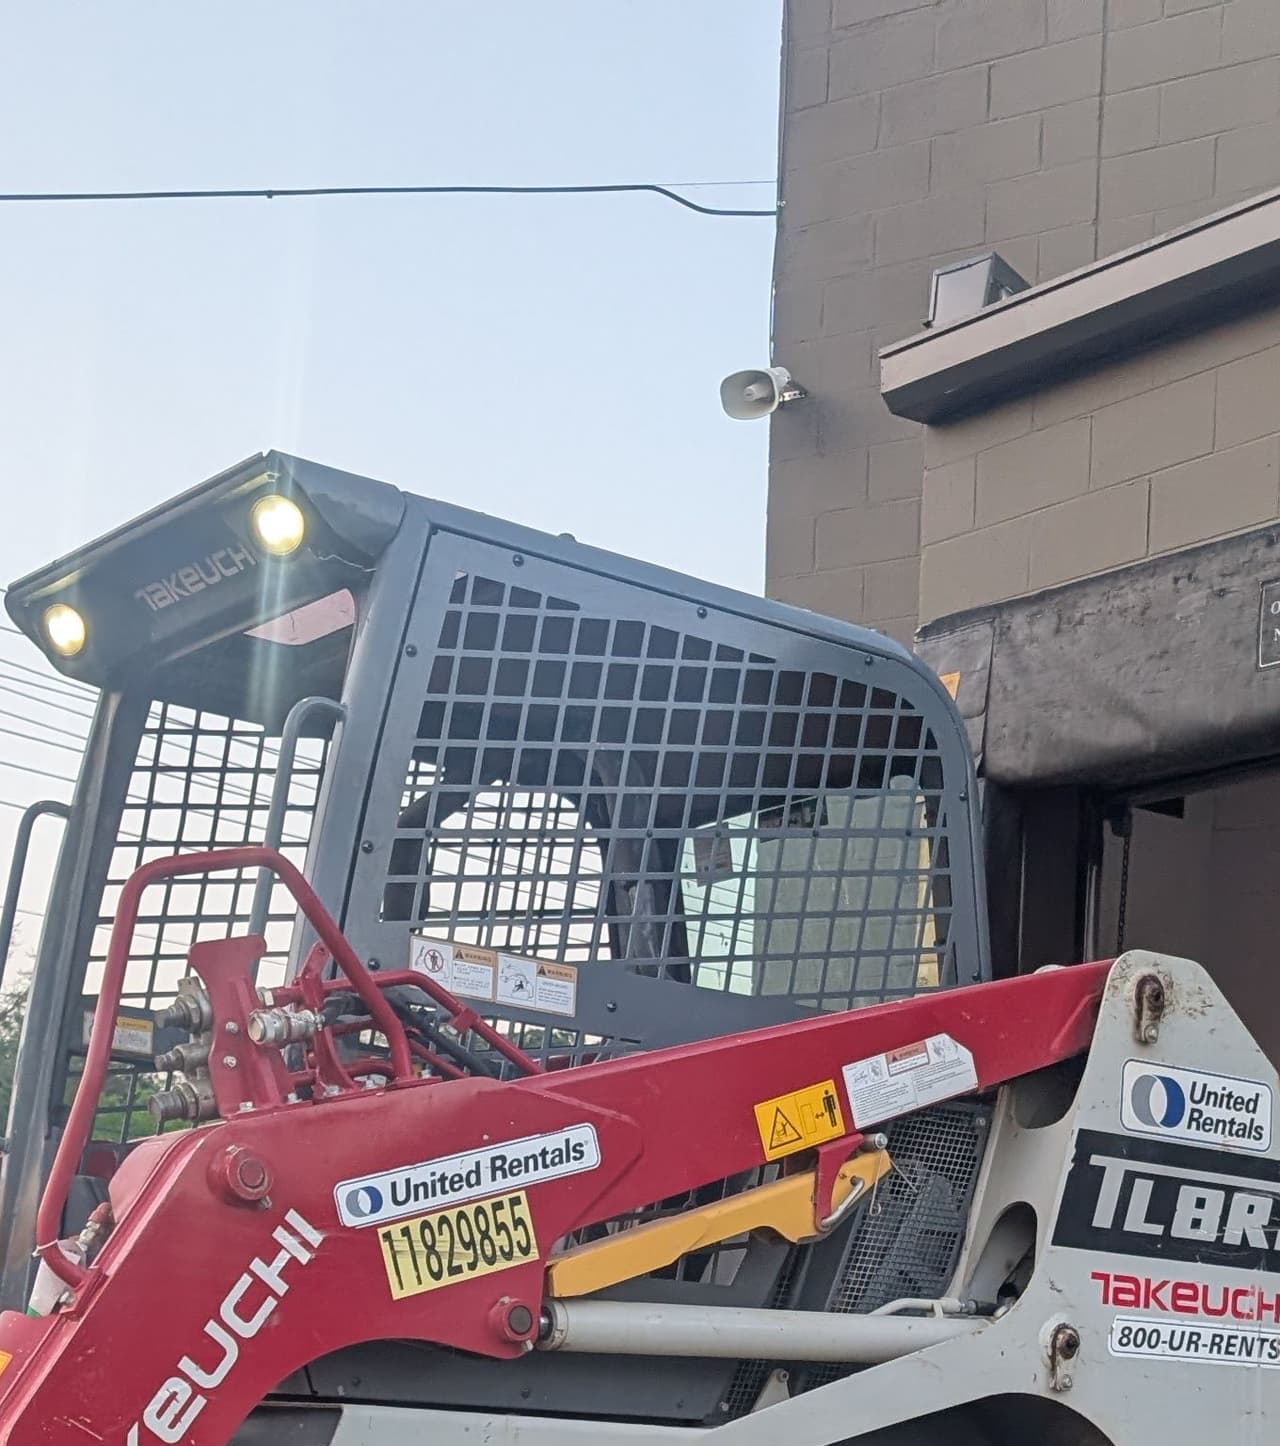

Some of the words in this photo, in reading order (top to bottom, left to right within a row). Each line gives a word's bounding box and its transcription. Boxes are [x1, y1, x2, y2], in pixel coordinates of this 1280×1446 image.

[1188, 1081, 1260, 1114] United
[1186, 1108, 1264, 1141] Rentals
[390, 1159, 482, 1207] United
[490, 1138, 586, 1182] Rentals
[382, 1195, 532, 1291] 11829855
